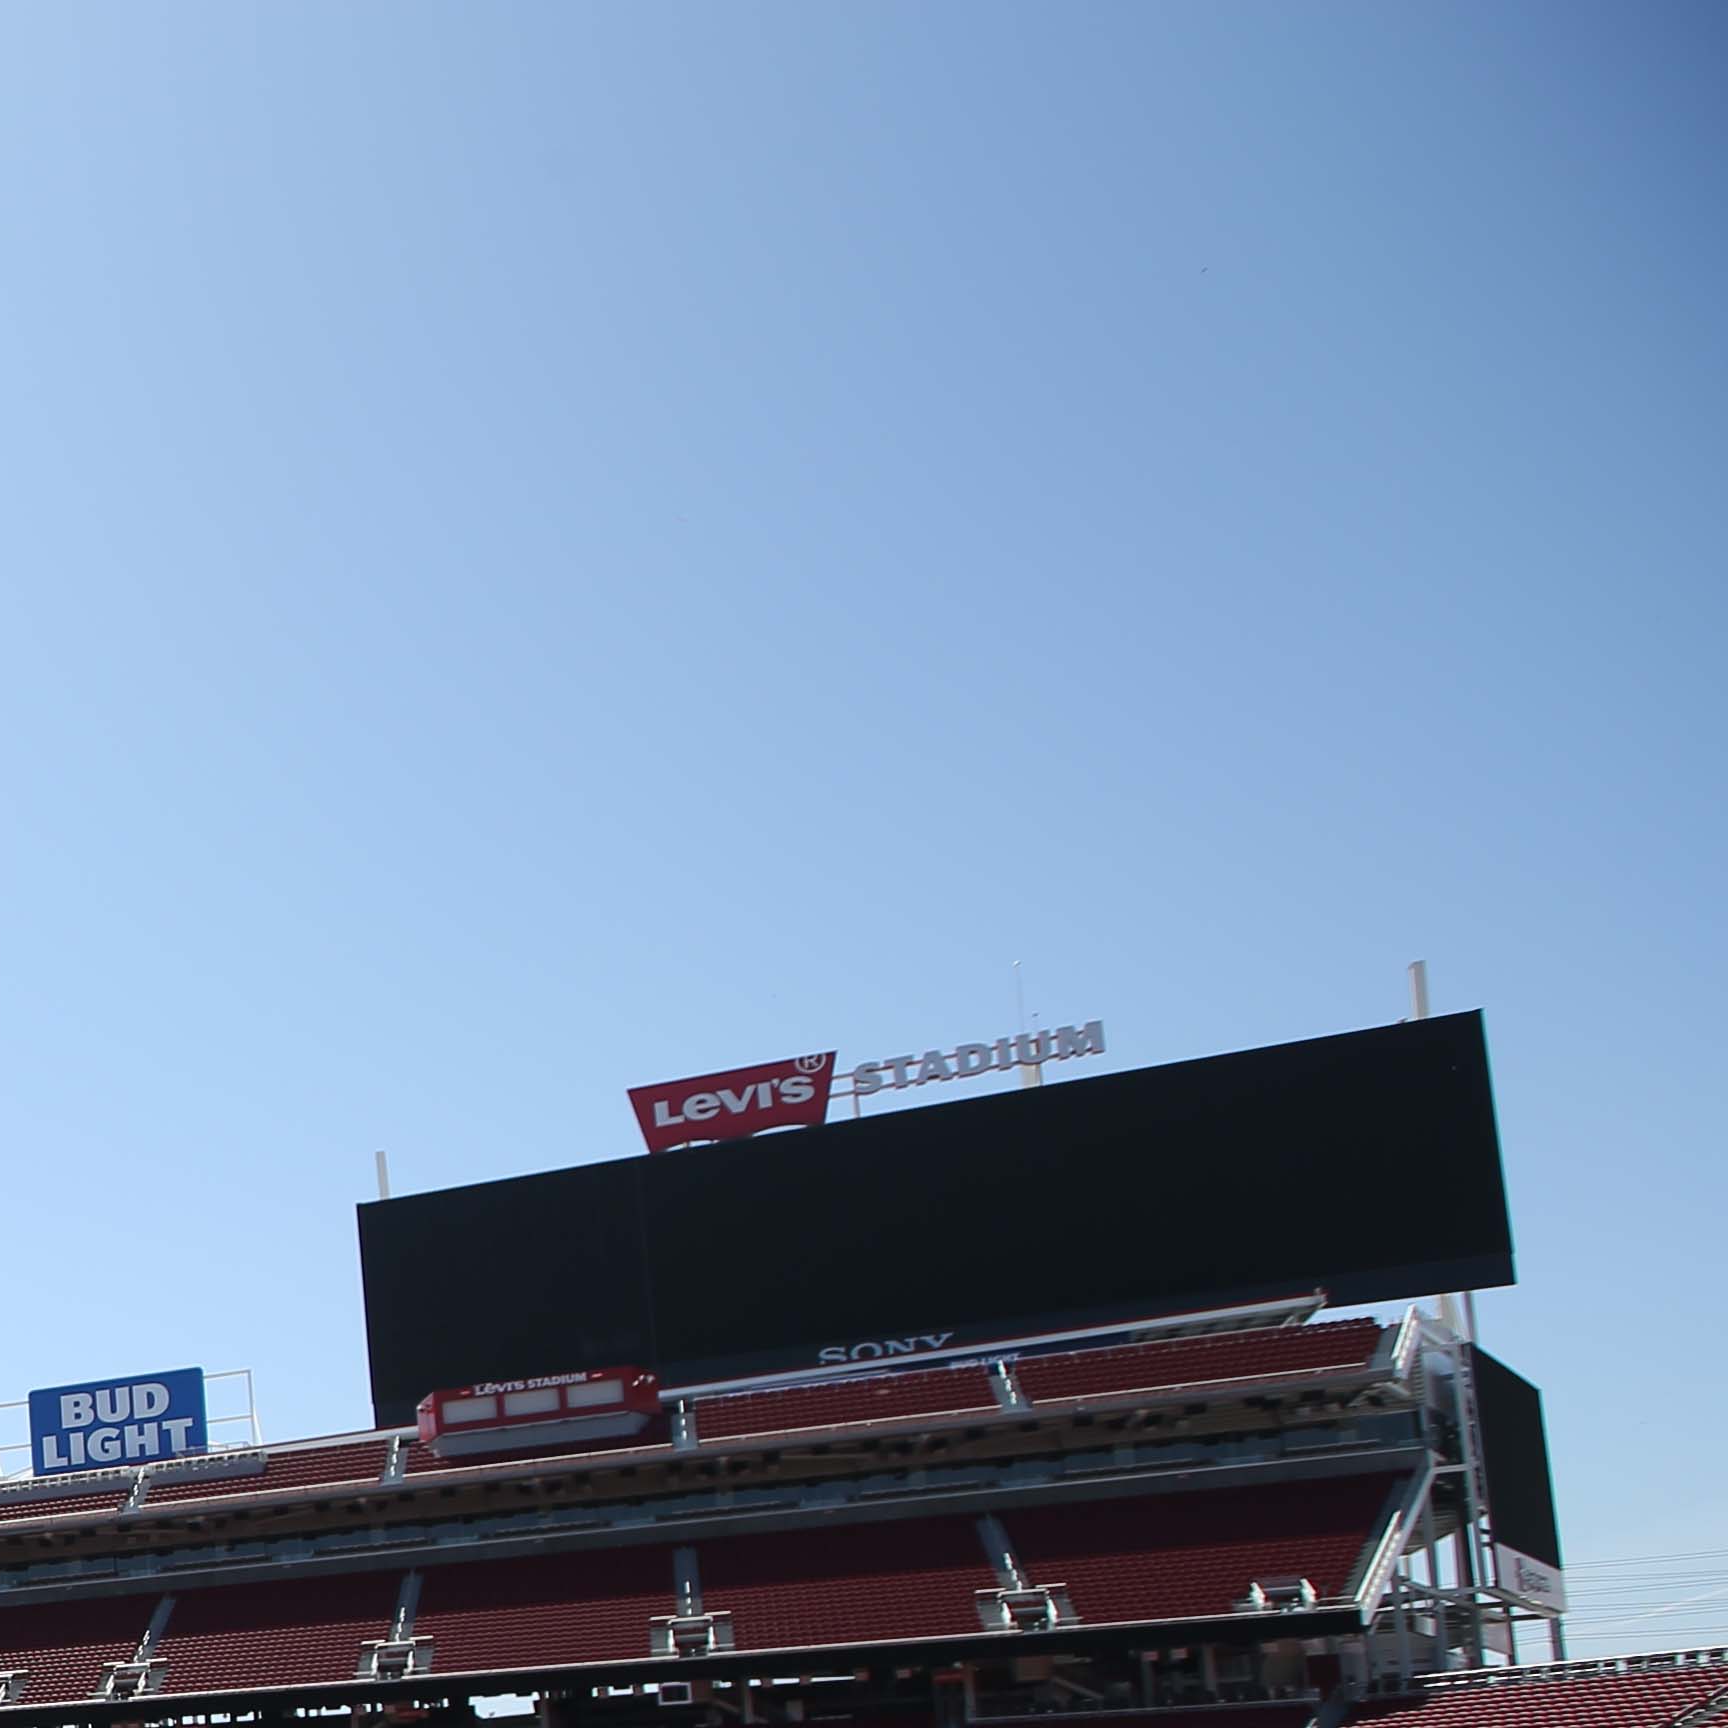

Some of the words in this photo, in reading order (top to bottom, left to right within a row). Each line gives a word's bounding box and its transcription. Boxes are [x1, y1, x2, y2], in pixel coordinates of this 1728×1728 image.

[853, 1019, 1105, 1094] STADIUM
[818, 1332, 955, 1365] SONY
[527, 1372, 587, 1390] STADIUM
[60, 1382, 169, 1429] BUD
[43, 1417, 194, 1469] LIGHT
